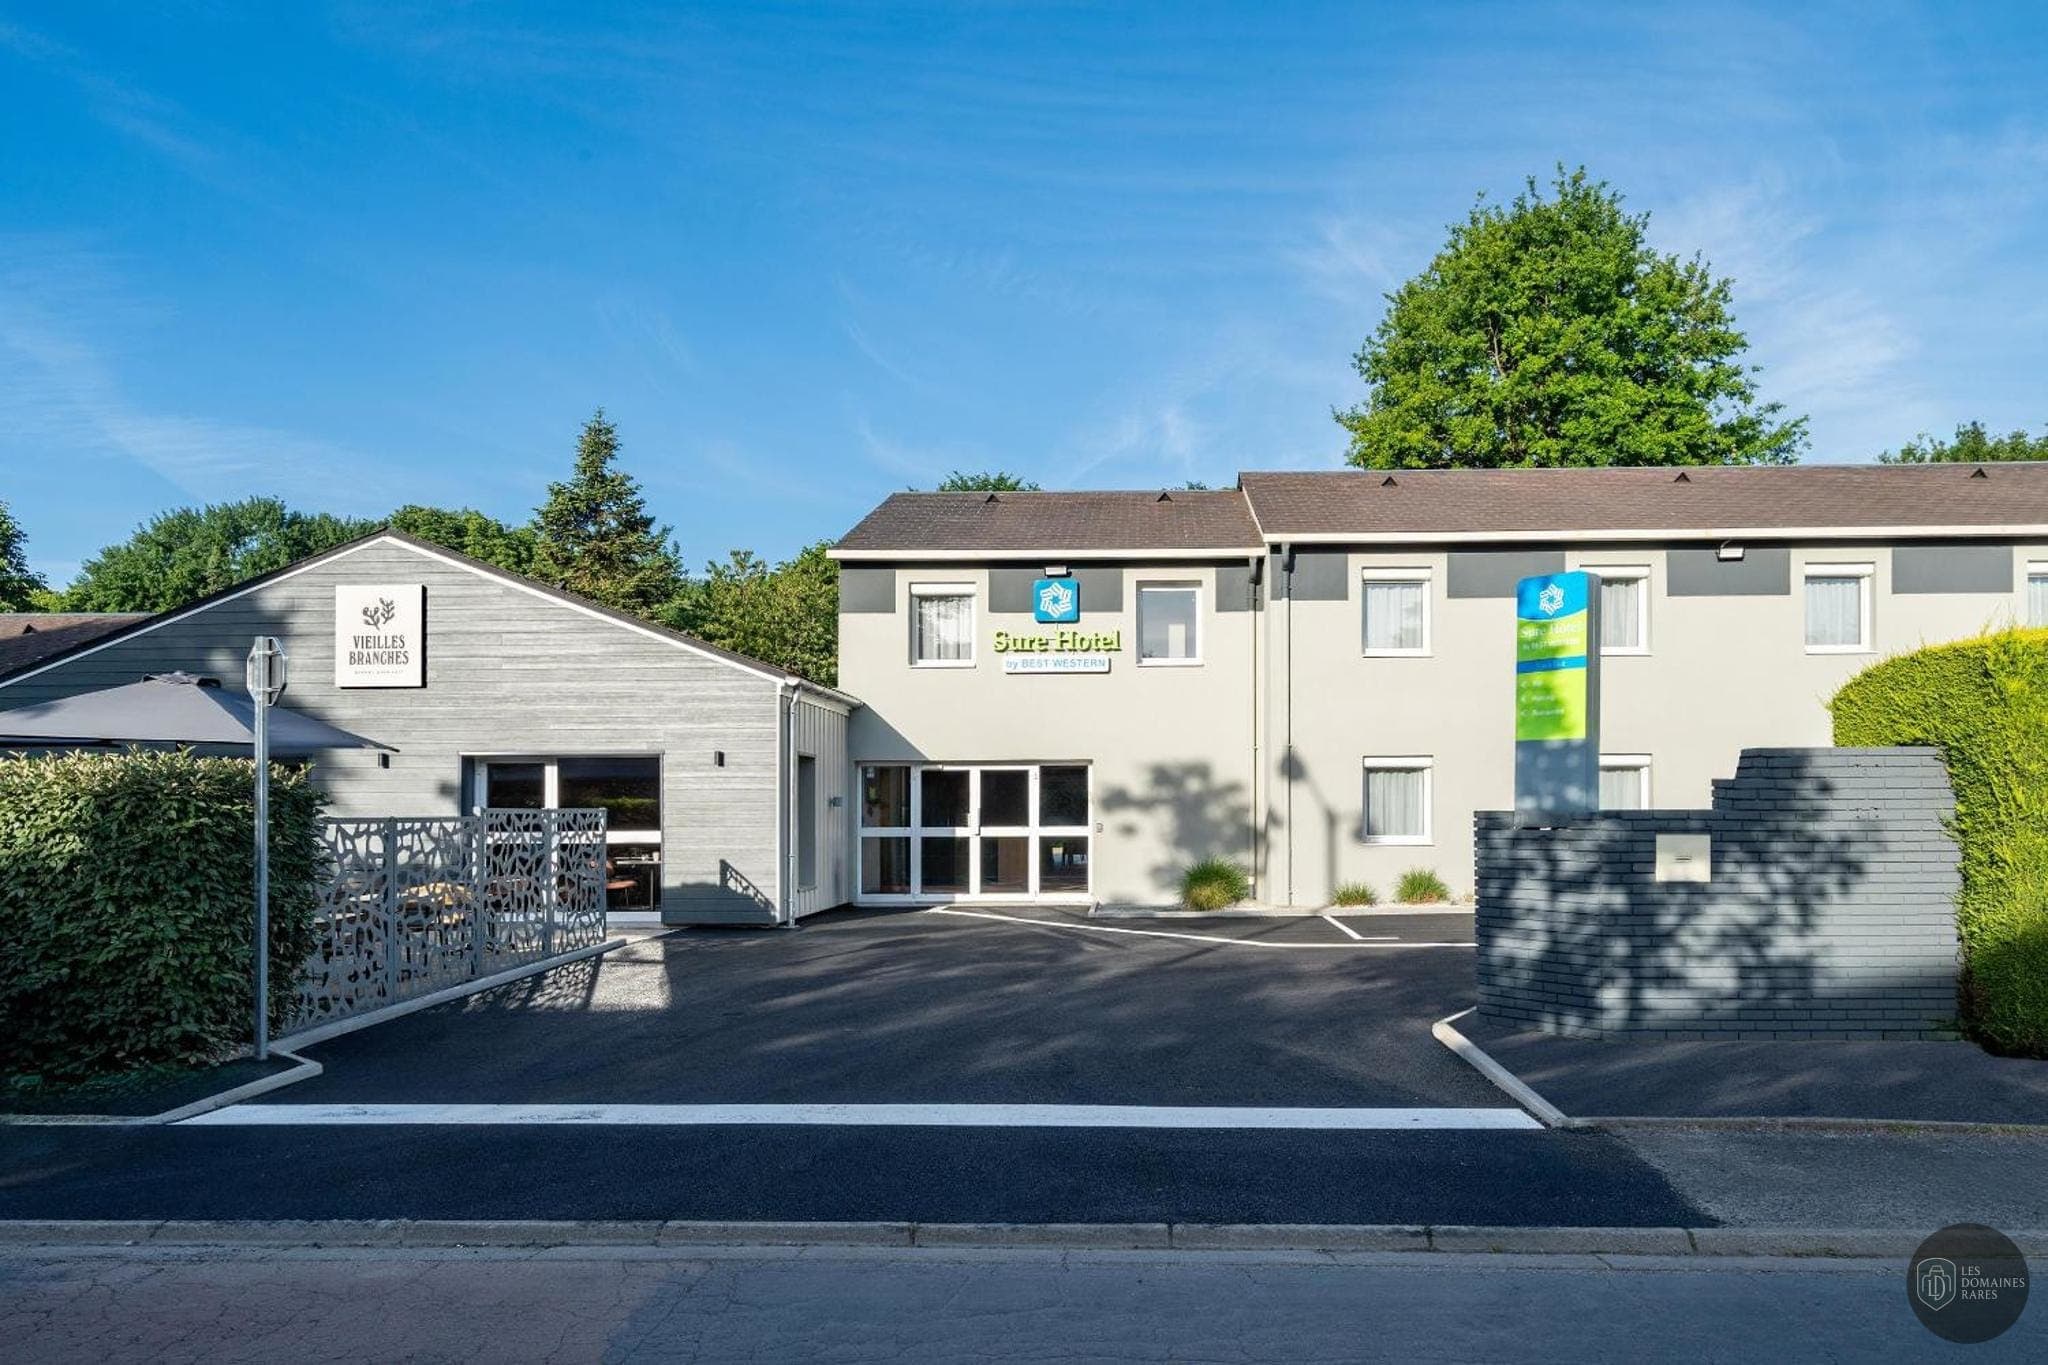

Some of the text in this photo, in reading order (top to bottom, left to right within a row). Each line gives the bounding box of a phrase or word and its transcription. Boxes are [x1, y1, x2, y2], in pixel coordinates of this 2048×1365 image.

[353, 635, 405, 649] VIEILLES
[994, 630, 1121, 652] Sure Hotel
[349, 650, 409, 665] BRANCHES
[1021, 659, 1049, 667] BEST
[1052, 658, 1105, 667] WESTERN
